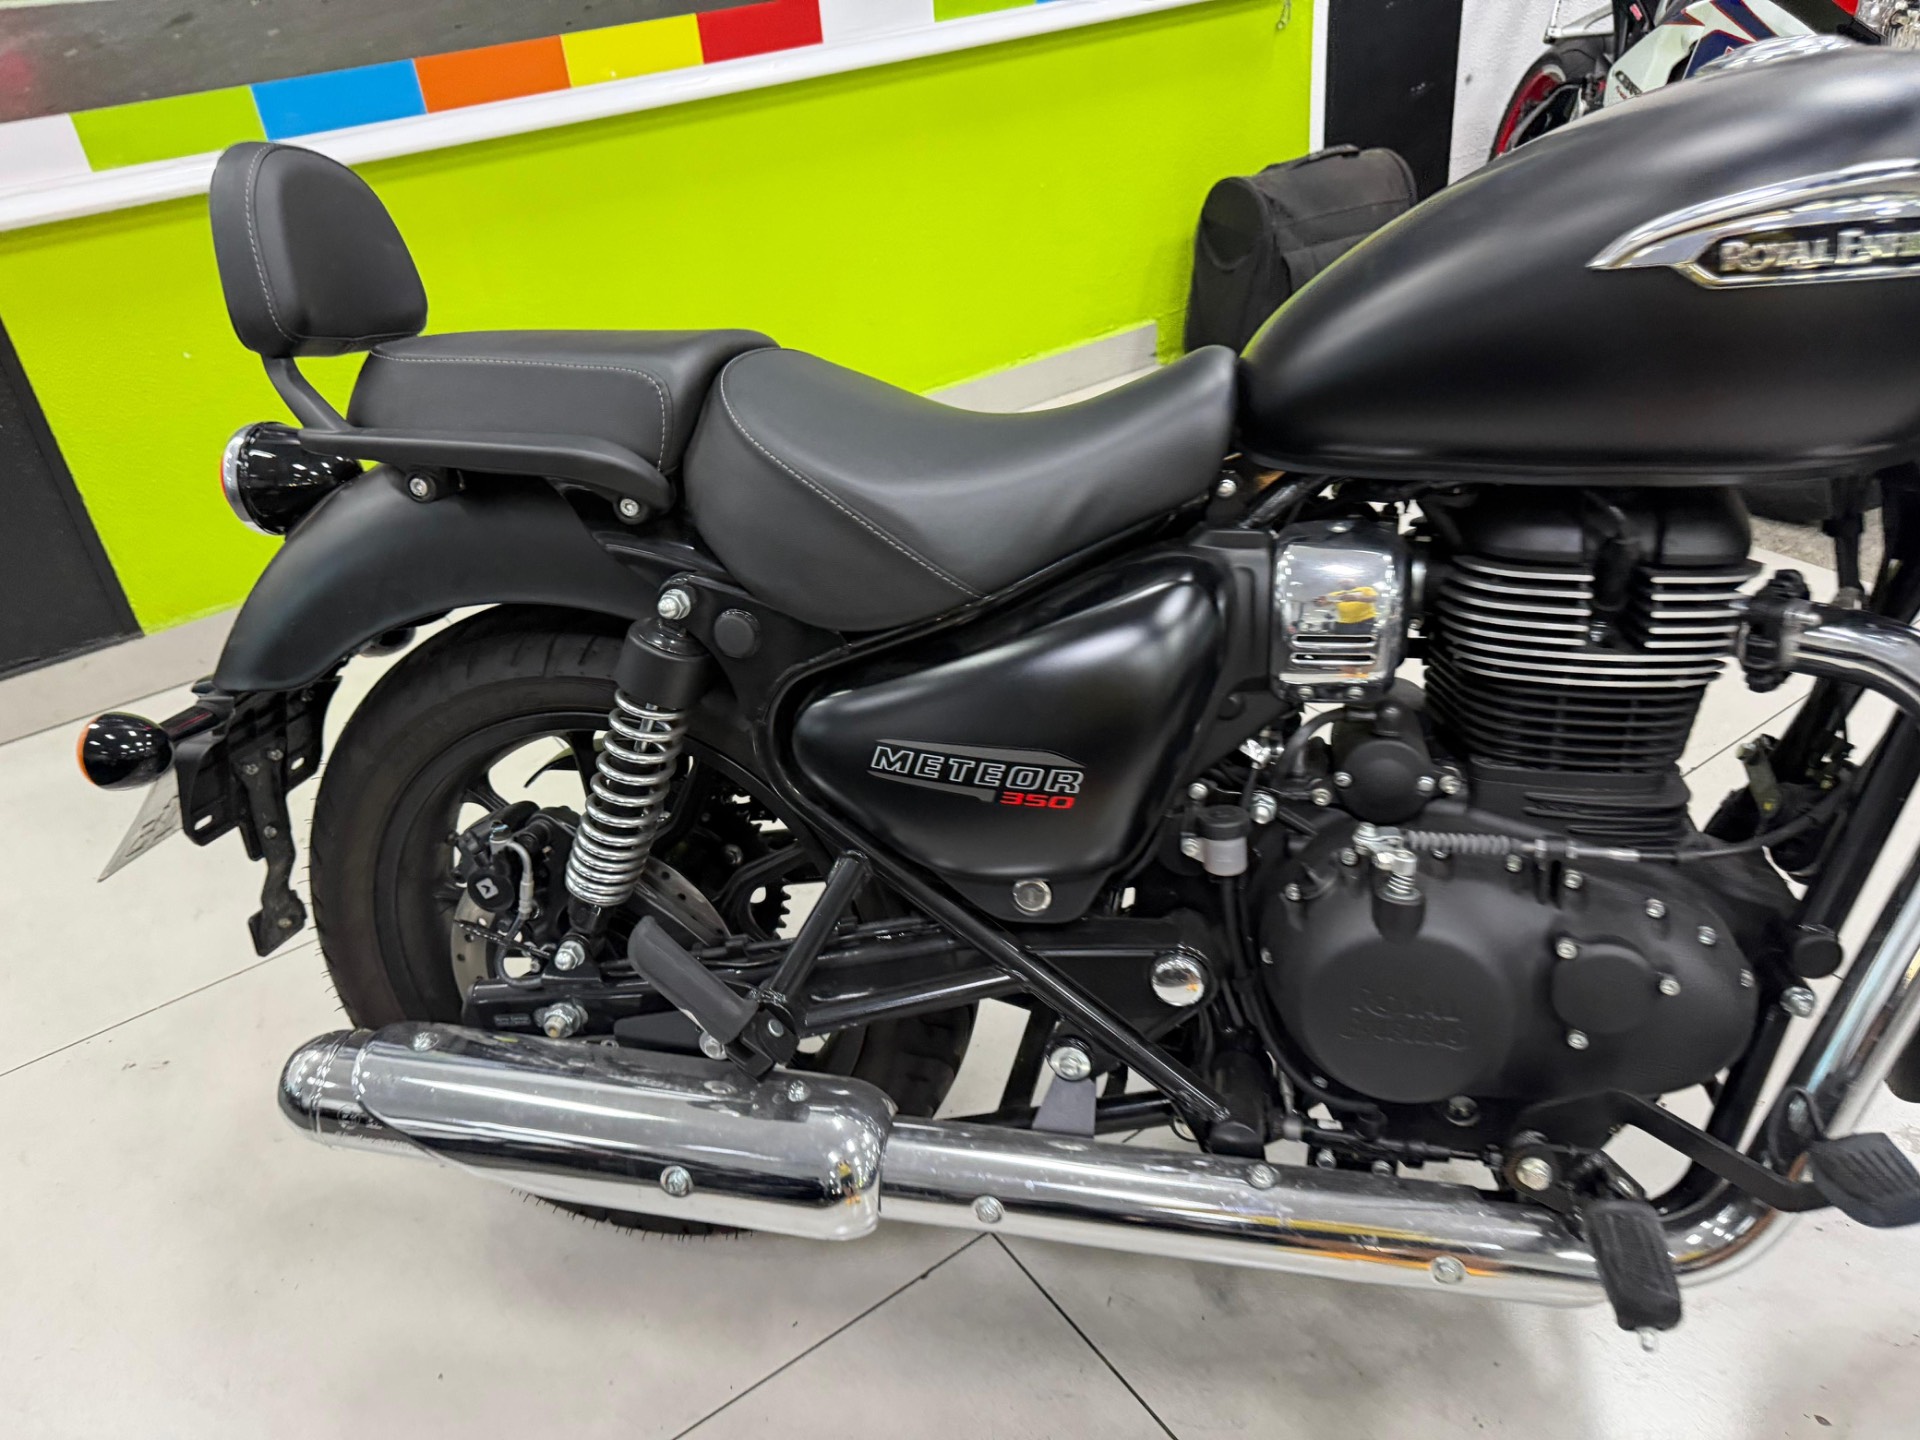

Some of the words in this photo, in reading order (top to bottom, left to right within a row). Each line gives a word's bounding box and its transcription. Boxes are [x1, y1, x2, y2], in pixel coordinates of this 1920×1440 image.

[1719, 238, 1835, 272] ROYAL
[870, 746, 1085, 794] METEOR
[1000, 791, 1076, 809] 350
